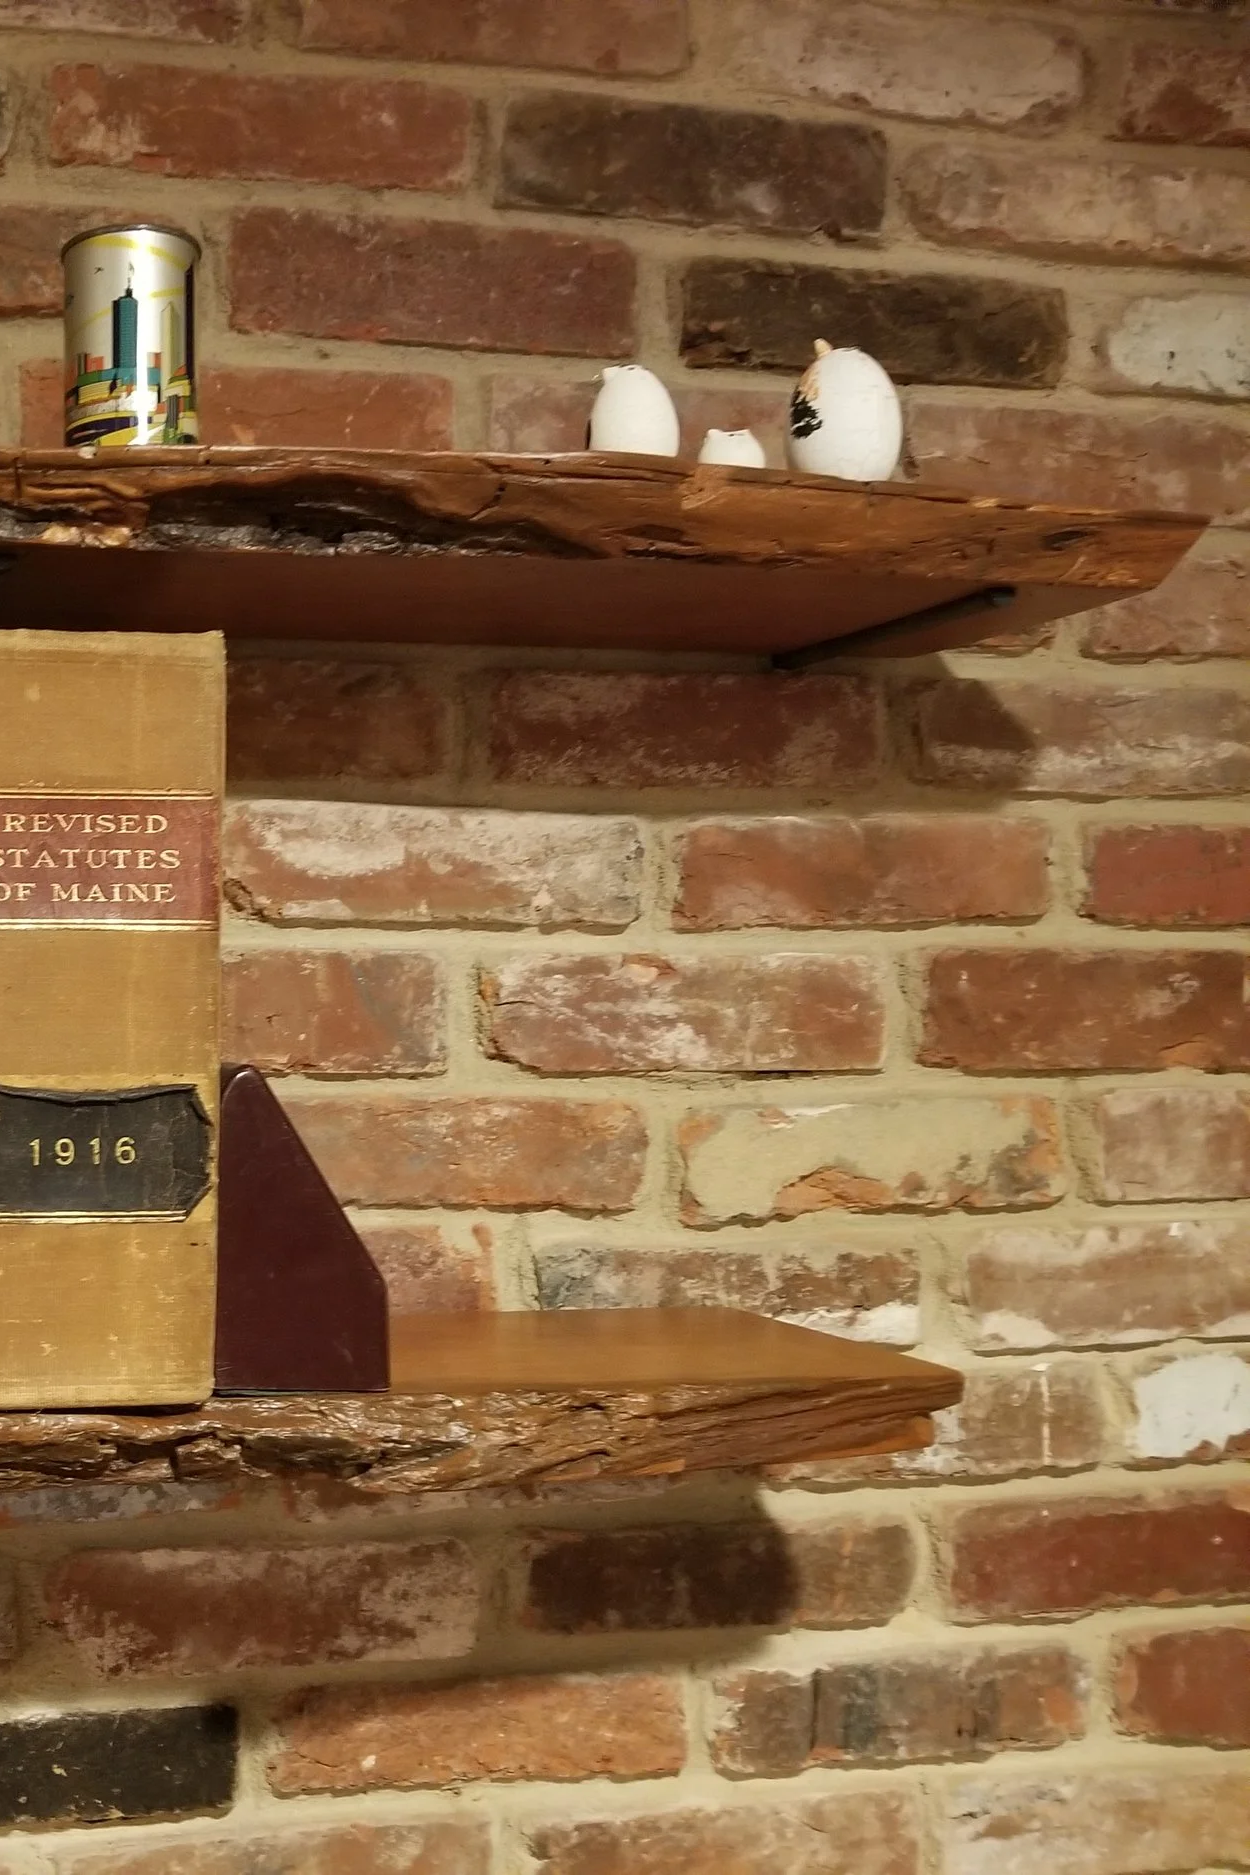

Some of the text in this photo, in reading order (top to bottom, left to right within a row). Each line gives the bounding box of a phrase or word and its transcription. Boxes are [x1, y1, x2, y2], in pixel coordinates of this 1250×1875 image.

[2, 813, 169, 834] REVISED
[50, 882, 177, 903] MAINE
[28, 1136, 137, 1166] 1916
